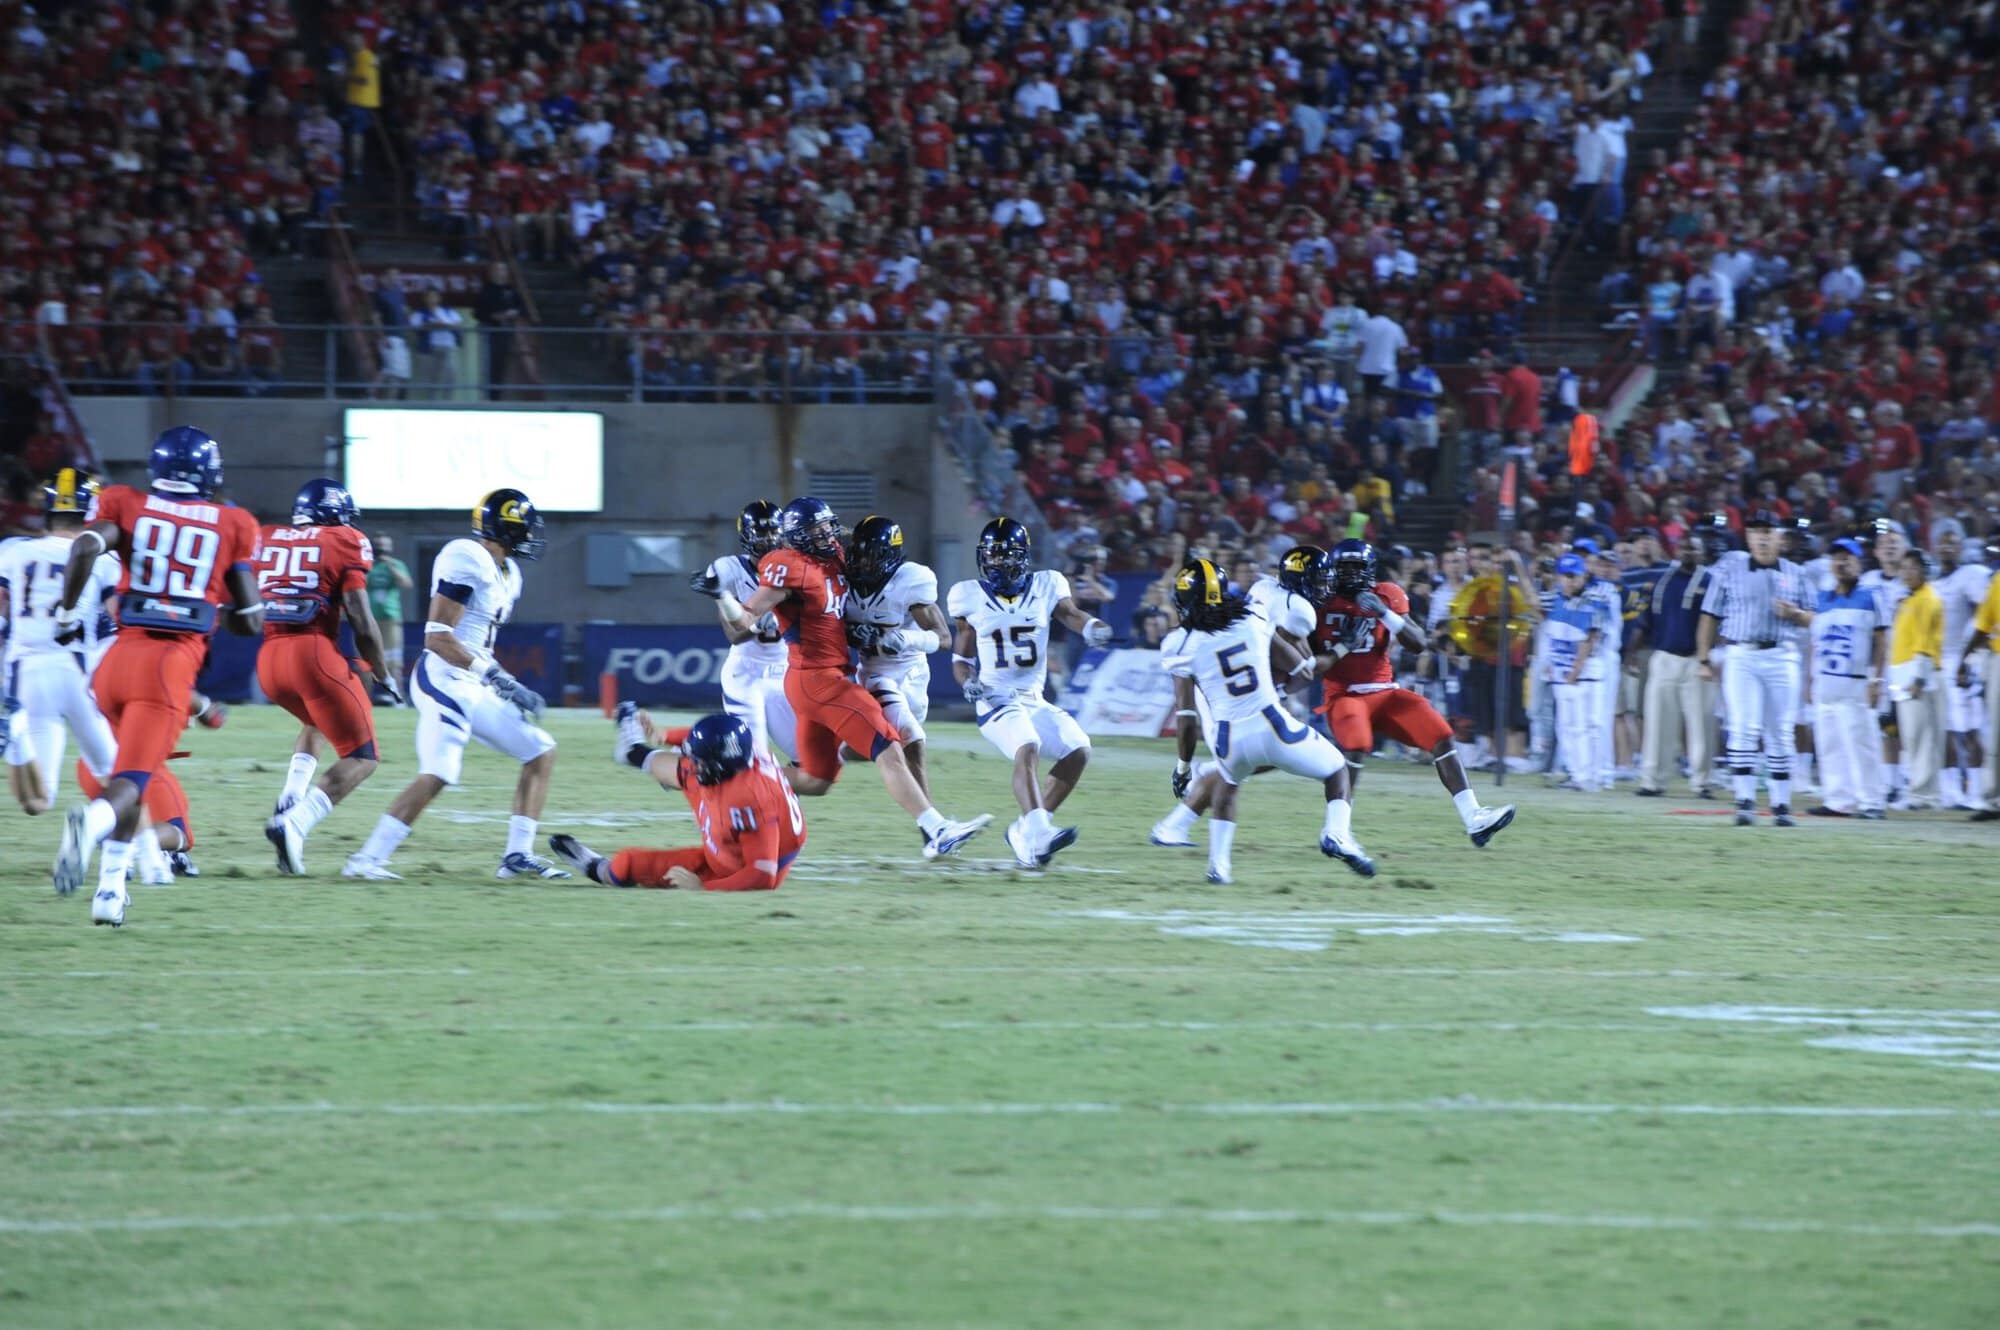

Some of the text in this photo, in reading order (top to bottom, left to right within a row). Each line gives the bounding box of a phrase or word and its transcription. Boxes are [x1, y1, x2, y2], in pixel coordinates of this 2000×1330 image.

[132, 516, 220, 598] 89
[258, 546, 321, 590] 25
[764, 562, 789, 588] 42
[992, 626, 1037, 669] 15
[1216, 642, 1258, 697] 5
